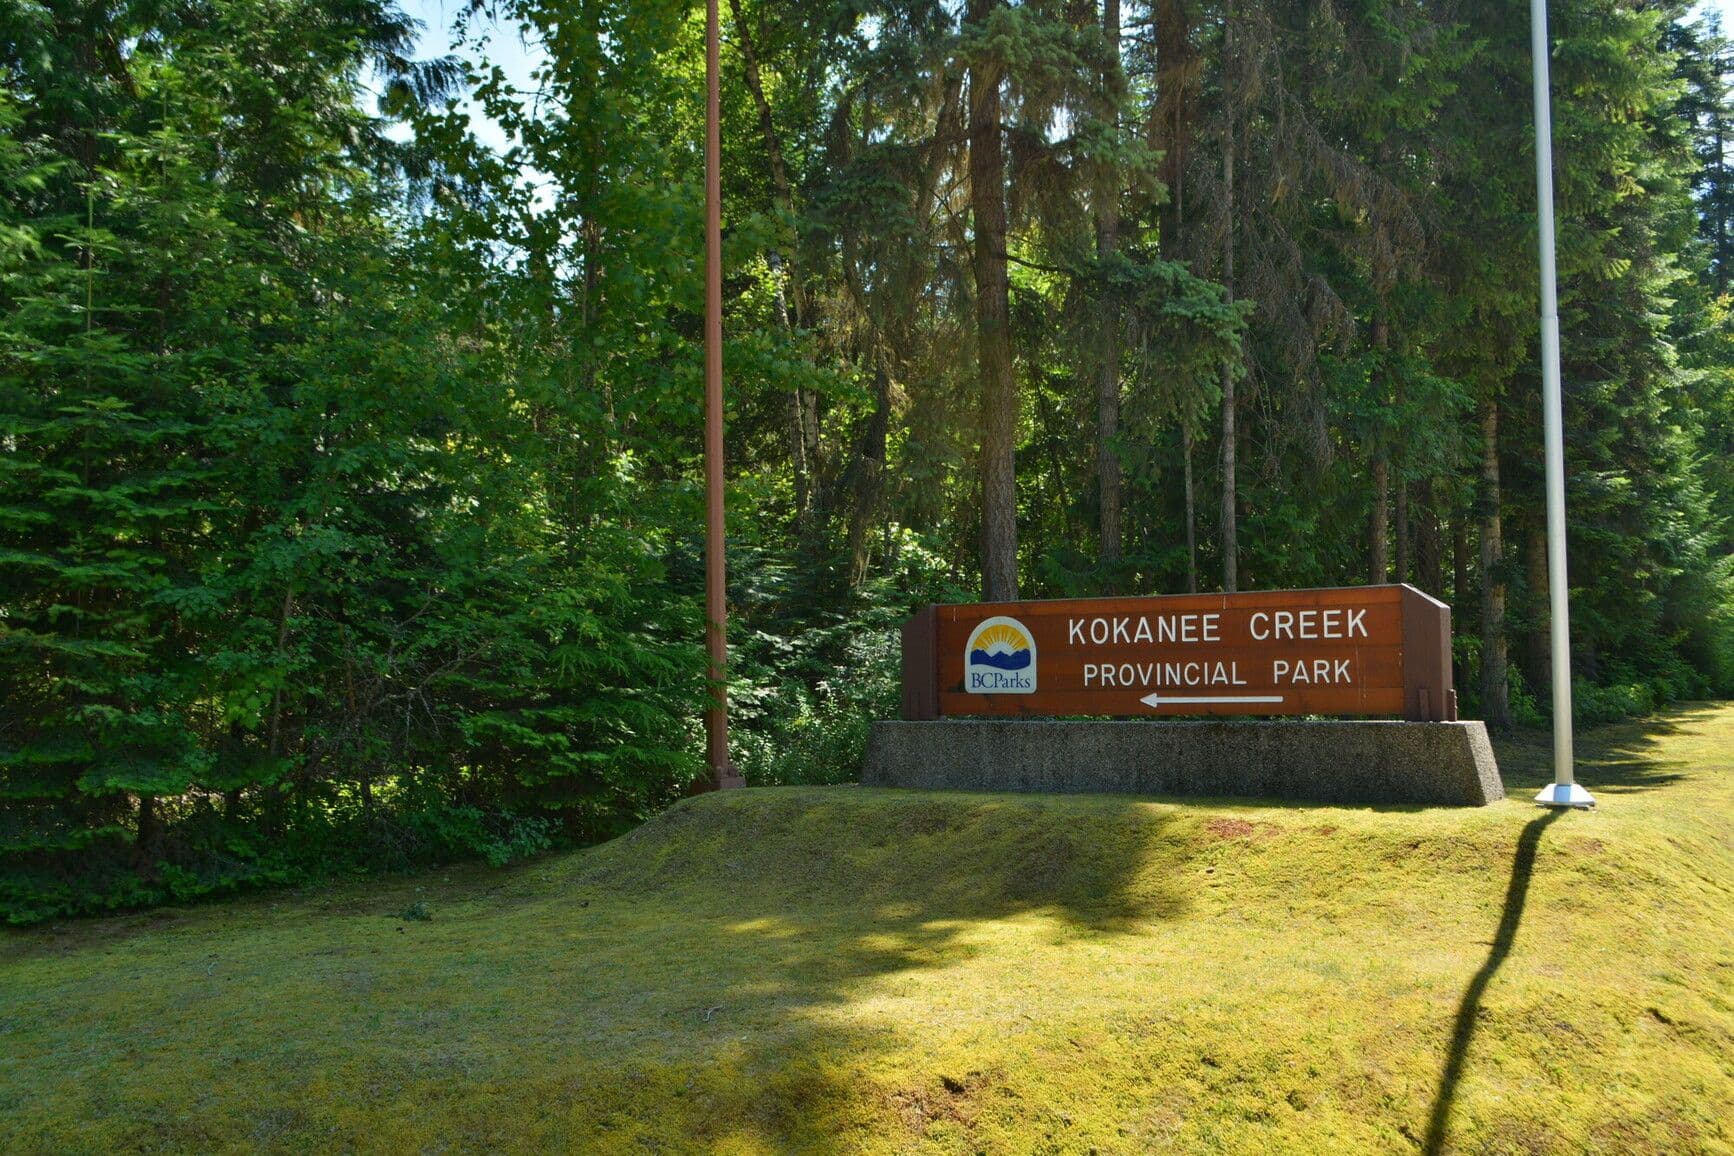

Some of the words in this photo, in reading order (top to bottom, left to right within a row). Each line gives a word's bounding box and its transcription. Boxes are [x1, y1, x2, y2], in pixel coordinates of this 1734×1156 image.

[1068, 614, 1221, 645] KOKANEE
[1250, 609, 1368, 640] CREEK
[1083, 661, 1247, 686] PROVINCIAL
[1273, 659, 1352, 684] PARK
